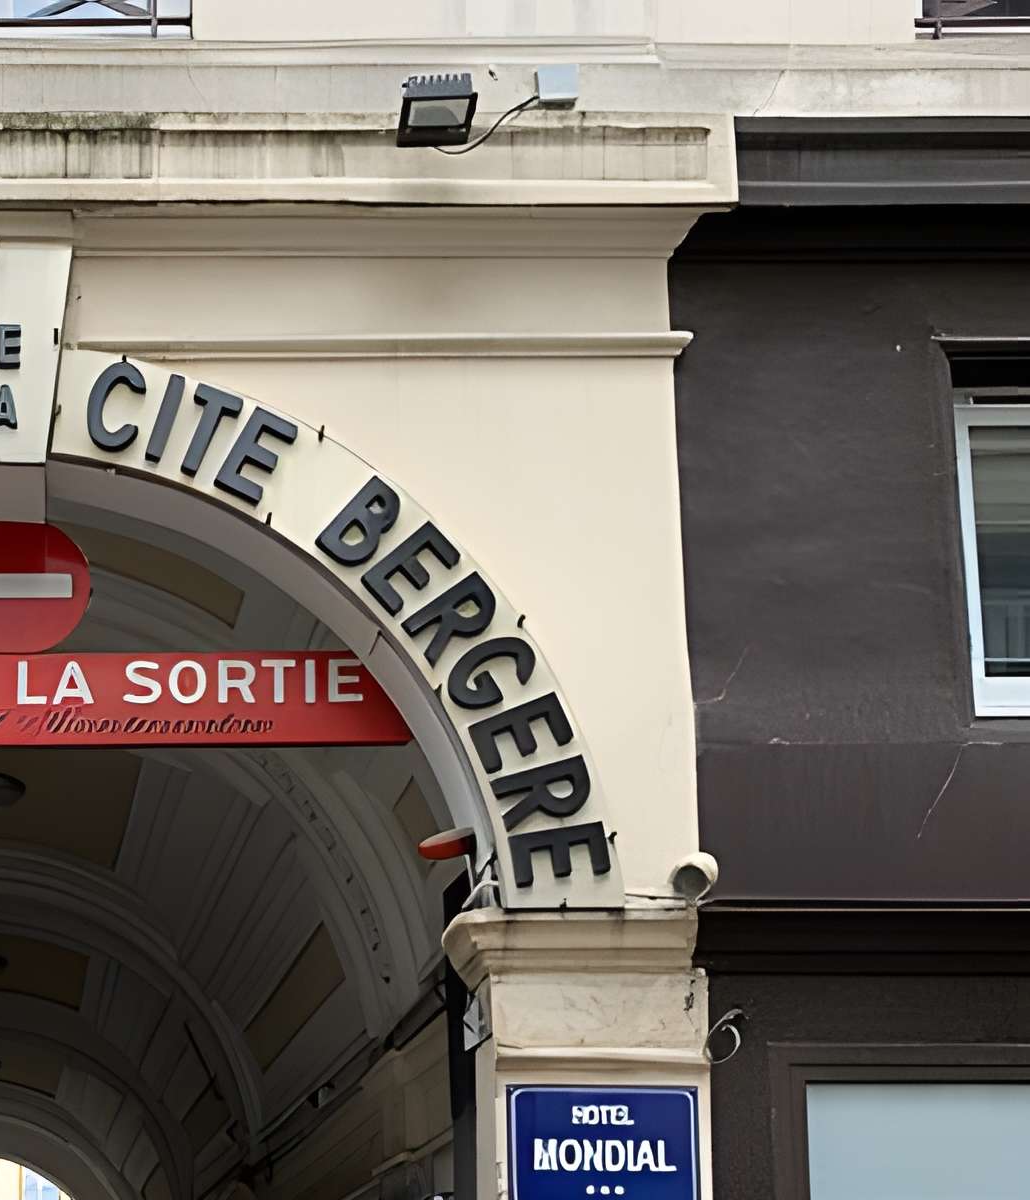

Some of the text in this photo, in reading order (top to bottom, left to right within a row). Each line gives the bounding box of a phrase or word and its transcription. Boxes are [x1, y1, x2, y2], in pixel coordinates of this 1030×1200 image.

[86, 362, 612, 890] CITE BERGERE
[17, 660, 95, 705] LA
[122, 659, 365, 705] SORTIE
[533, 1138, 678, 1172] MONDIAL
